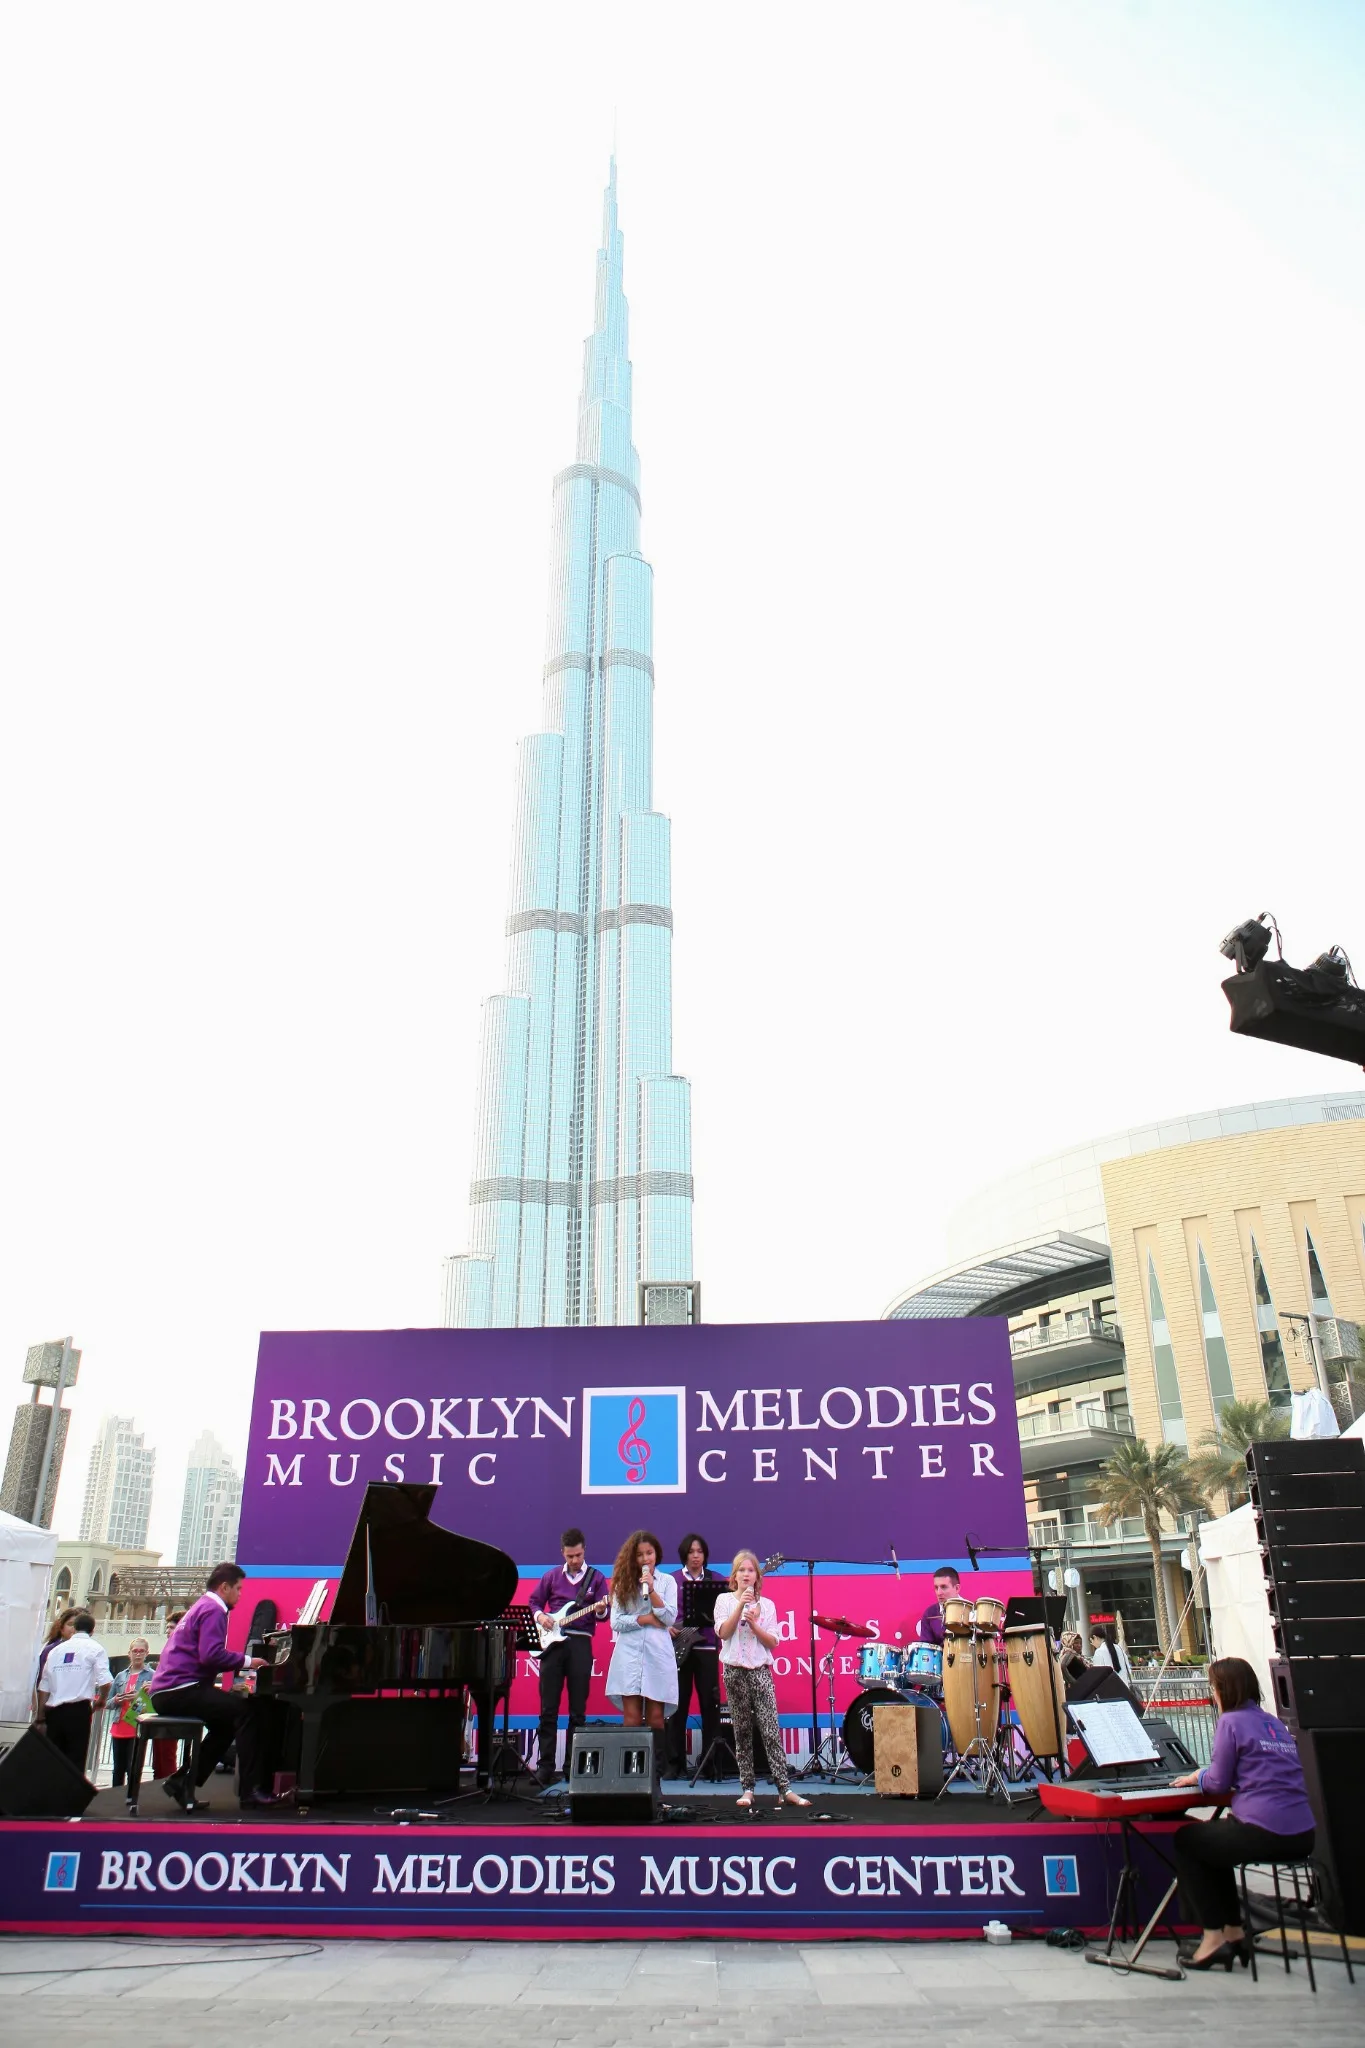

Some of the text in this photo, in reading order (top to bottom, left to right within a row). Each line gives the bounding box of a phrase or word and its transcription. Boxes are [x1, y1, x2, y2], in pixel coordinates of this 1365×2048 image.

[267, 1382, 996, 1441] BROOKLYN MELODIES
[263, 1442, 1004, 1487] MUSIC CENTER
[97, 1850, 1026, 1896] BROOKLYN MELODIES MUSIC CENTER
